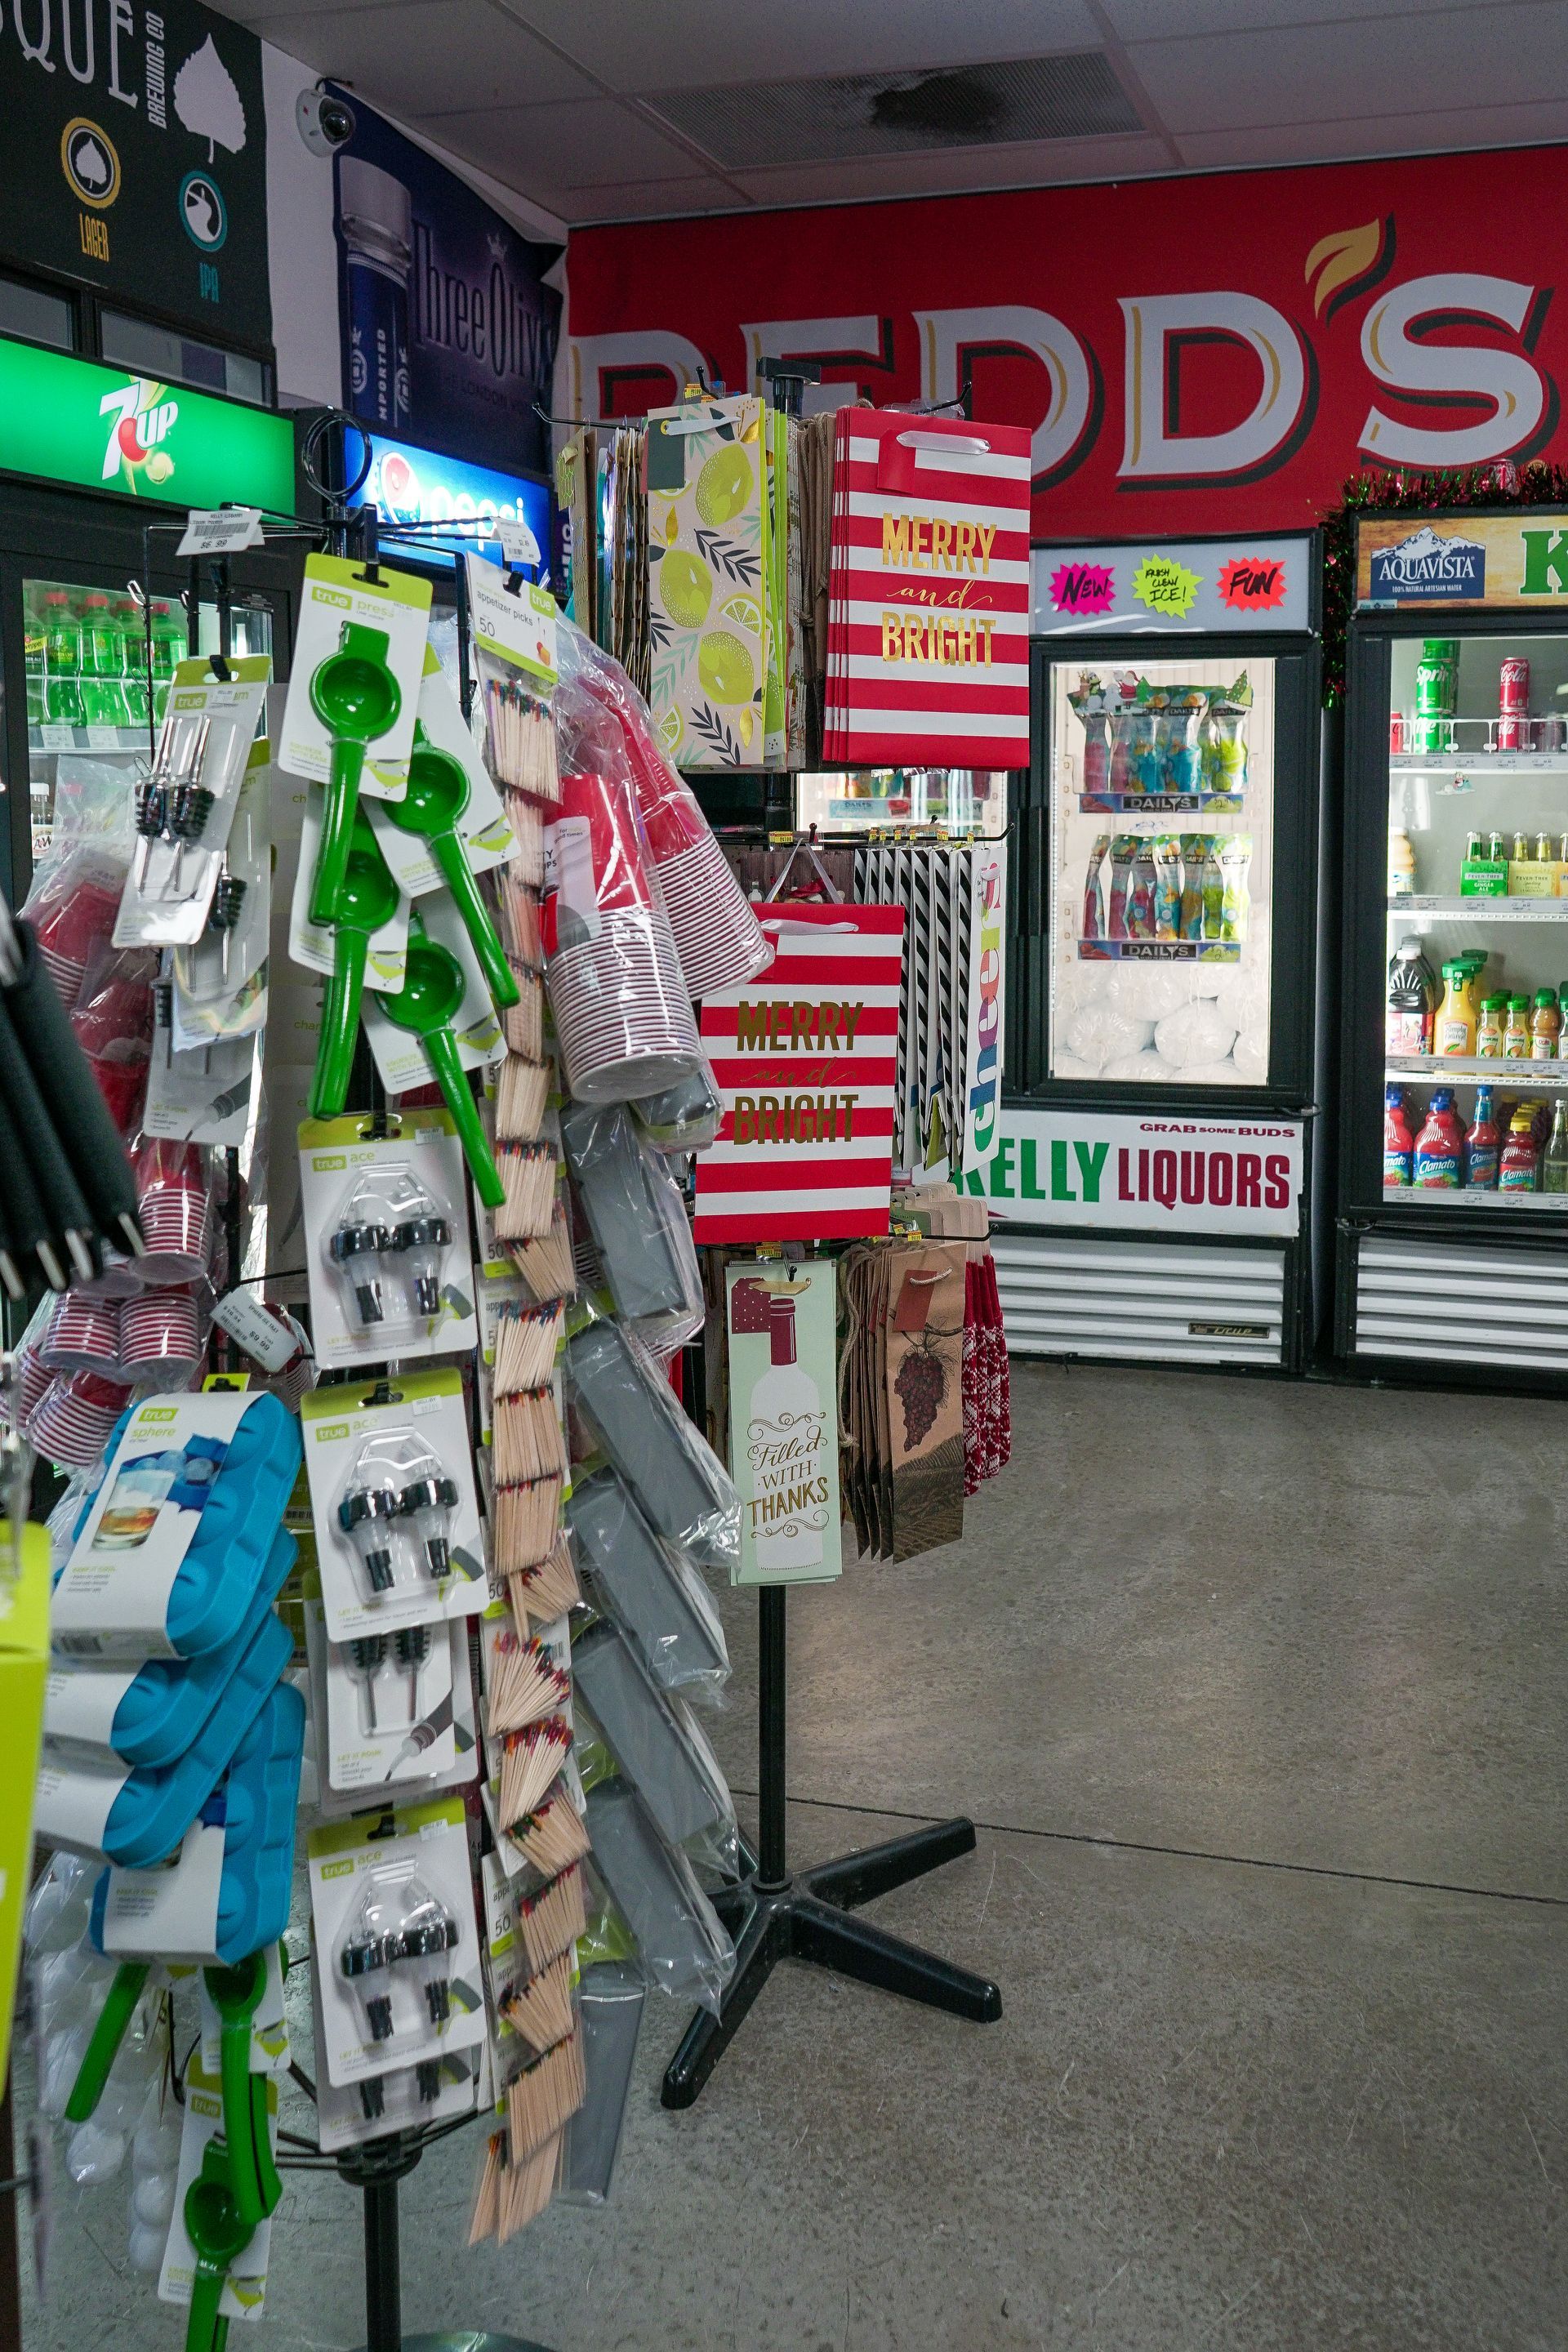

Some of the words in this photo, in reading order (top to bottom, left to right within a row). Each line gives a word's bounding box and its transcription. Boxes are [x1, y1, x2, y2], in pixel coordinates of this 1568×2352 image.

[145, 11, 164, 42] CO
[145, 41, 167, 130] BREWING
[78, 212, 109, 263] LAGER
[198, 262, 220, 304] IPA
[882, 512, 998, 575] MERRY
[1379, 555, 1476, 586] AQUAVISTA
[1061, 570, 1110, 606] NEW
[1152, 576, 1178, 588] CLEAN
[1229, 566, 1279, 598] FUN
[1405, 585, 1424, 593] NATURAL
[1446, 584, 1463, 592] WATER
[315, 588, 349, 608] true
[532, 593, 552, 611] true
[885, 579, 993, 612] and
[1149, 586, 1187, 604] ICE!
[477, 590, 511, 615] appetizer
[512, 609, 533, 626] picks
[479, 617, 496, 637] 50
[881, 611, 997, 669] BRIGHT
[177, 697, 203, 707] true
[969, 862, 1001, 1152] cheers
[737, 1000, 864, 1052] MERRY
[1445, 1023, 1467, 1034] Simply
[740, 1056, 857, 1089] and
[733, 1094, 859, 1146] BRIGHT
[1139, 1122, 1197, 1134] GRAB
[1238, 1127, 1296, 1138] BUDS
[314, 1158, 344, 1169] true
[350, 1152, 376, 1163] ace
[1419, 1160, 1456, 1175] Clamato
[1118, 1147, 1291, 1211] LIQUORS
[1501, 1169, 1535, 1182] Clamato
[488, 1242, 504, 1261] 50
[143, 1410, 173, 1420] true
[352, 1419, 377, 1430] ace
[131, 1427, 176, 1438] sphere
[318, 1426, 346, 1439] true
[746, 1424, 828, 1471] Filled
[760, 1459, 813, 1490] WITH
[746, 1476, 829, 1527] THANKS
[489, 1582, 504, 1600] 50
[357, 1851, 382, 1864] ace
[323, 1862, 351, 1877] true
[494, 1913, 510, 1935] 50
